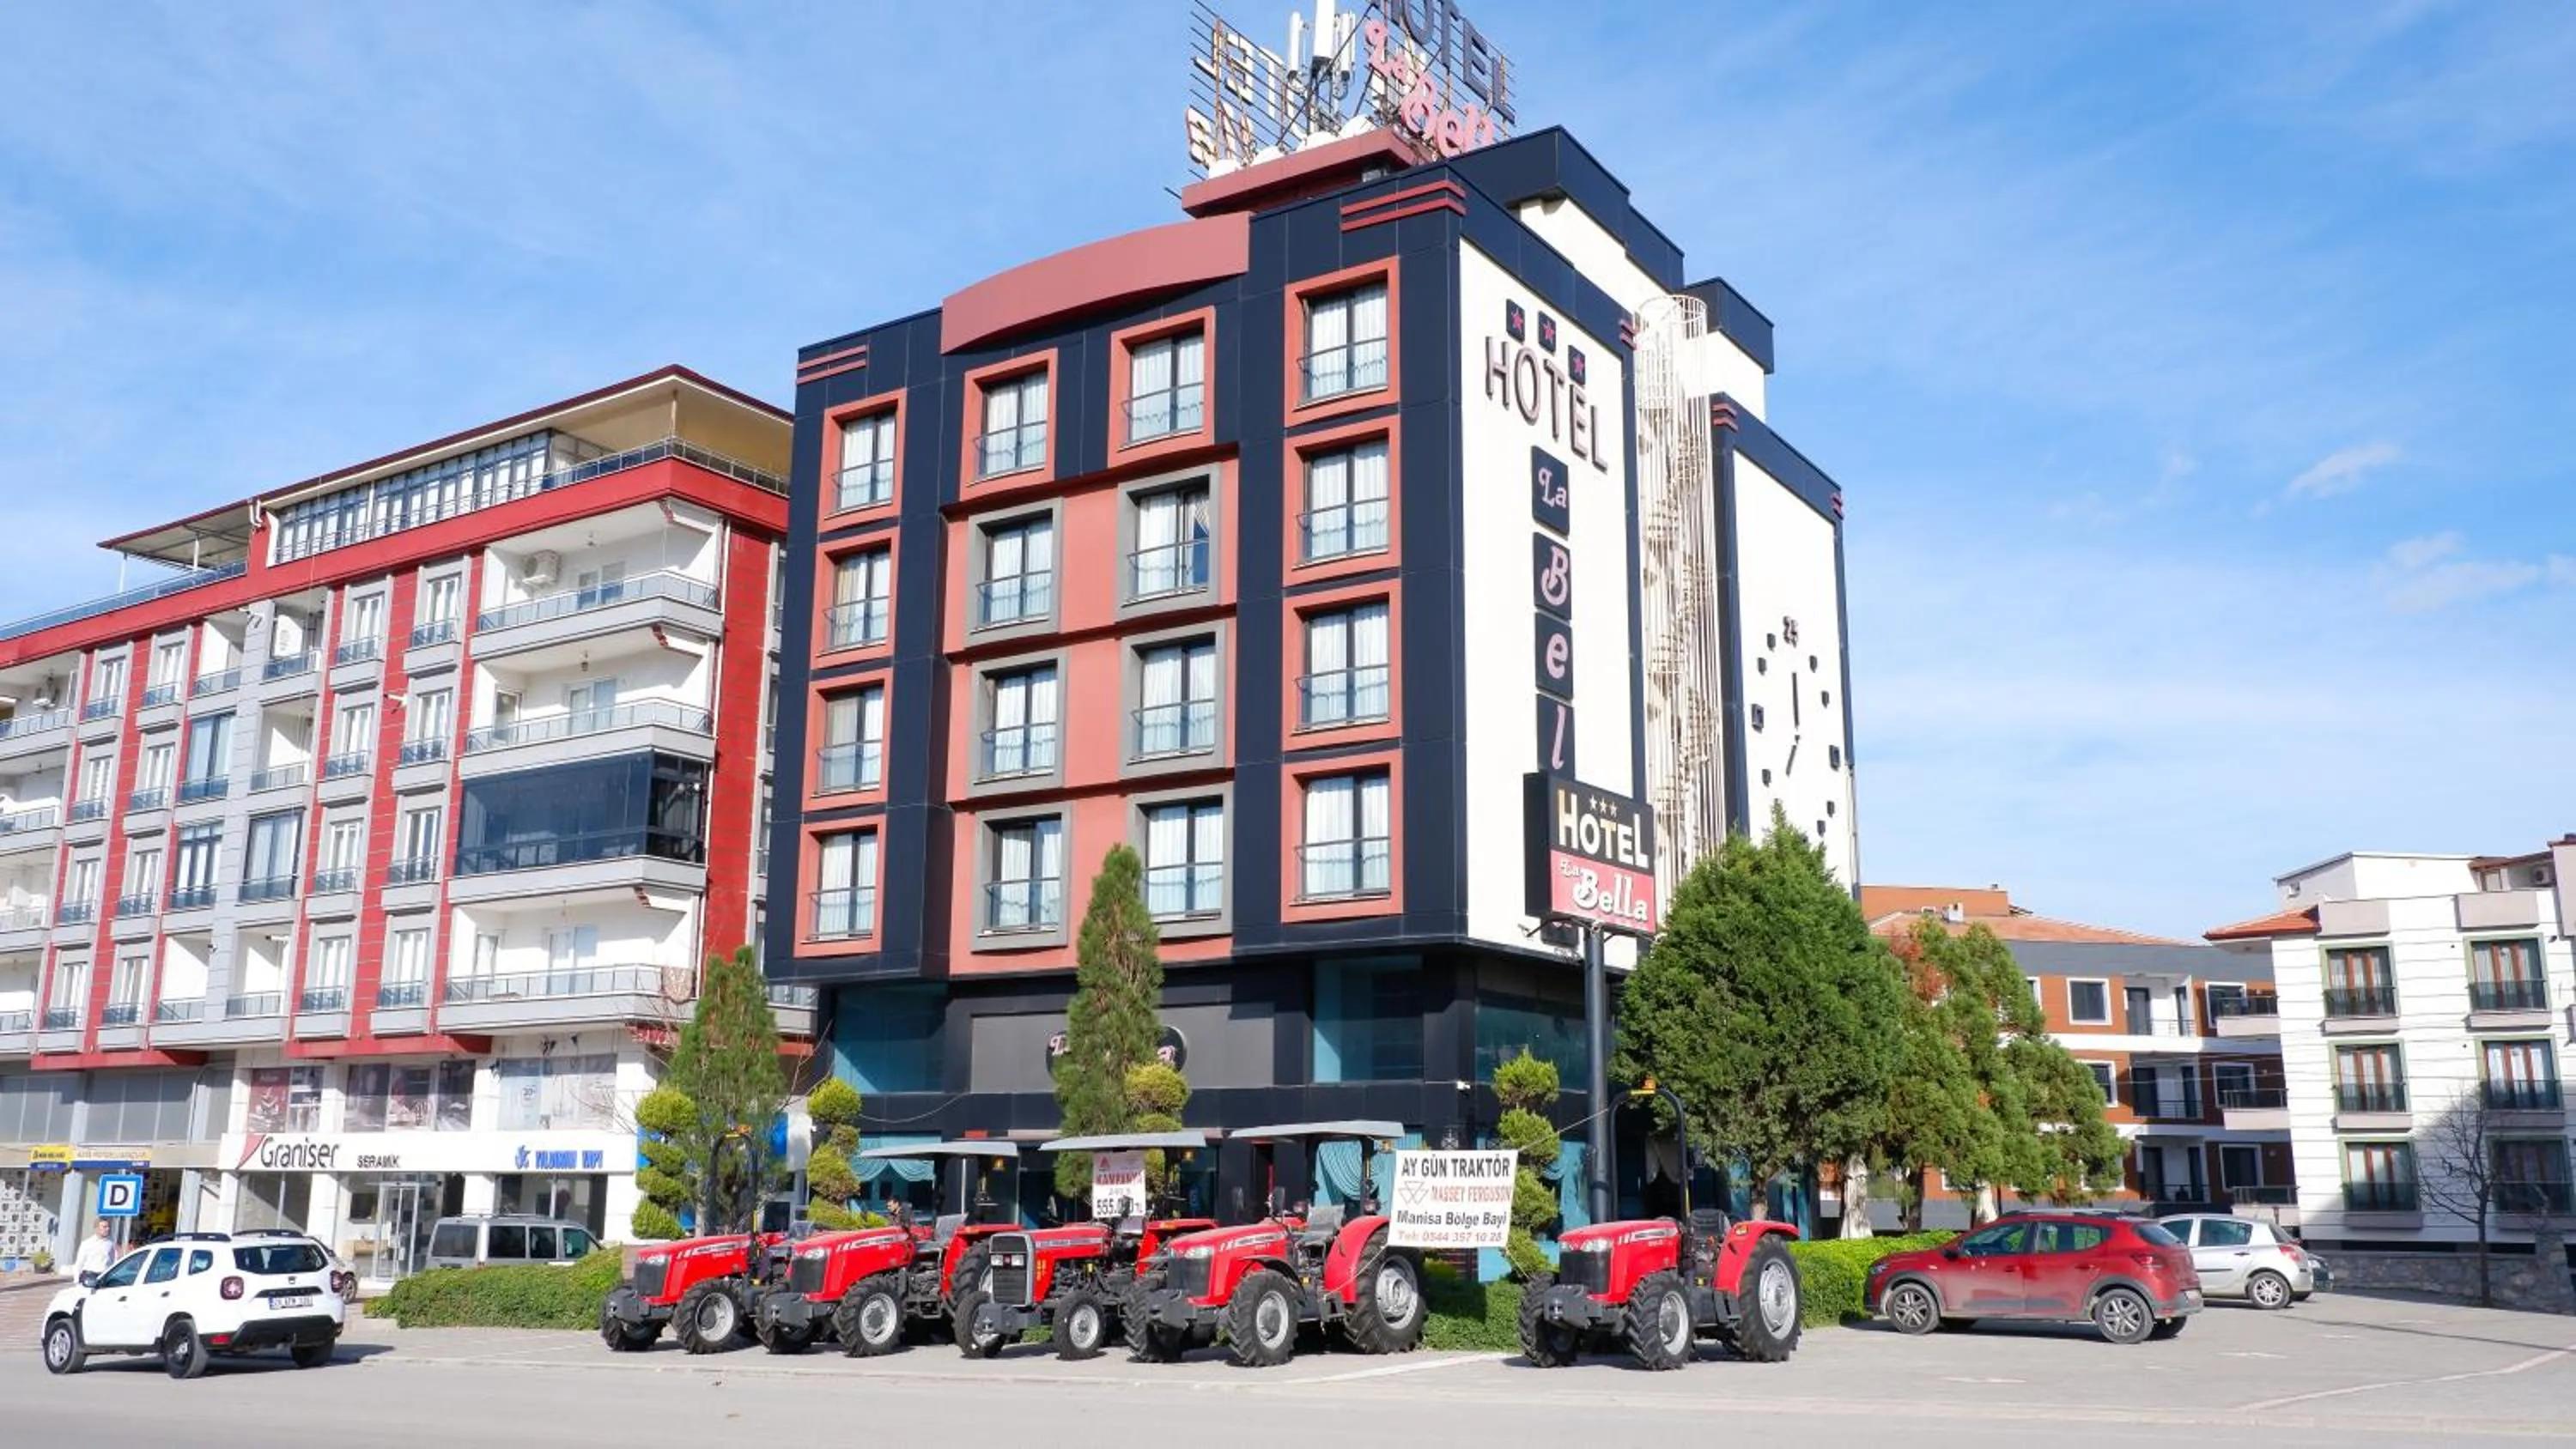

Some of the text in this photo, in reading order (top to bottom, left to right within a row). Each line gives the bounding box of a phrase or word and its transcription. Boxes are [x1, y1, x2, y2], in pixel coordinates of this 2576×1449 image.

[1374, 0, 1516, 124] OTEL
[1485, 336, 1608, 475] HOTEL
[1538, 467, 1568, 510] La
[1557, 789, 1649, 869] HOTEL
[1573, 869, 1649, 921] Bella
[260, 1137, 340, 1168] Graniser
[1401, 1154, 1510, 1178] AY GÜN TRAKTÖR
[109, 1185, 129, 1206] D
[1431, 1185, 1511, 1203] MASSEY FERGUSON
[1397, 1210, 1507, 1229] Manisa Bölge Bayi
